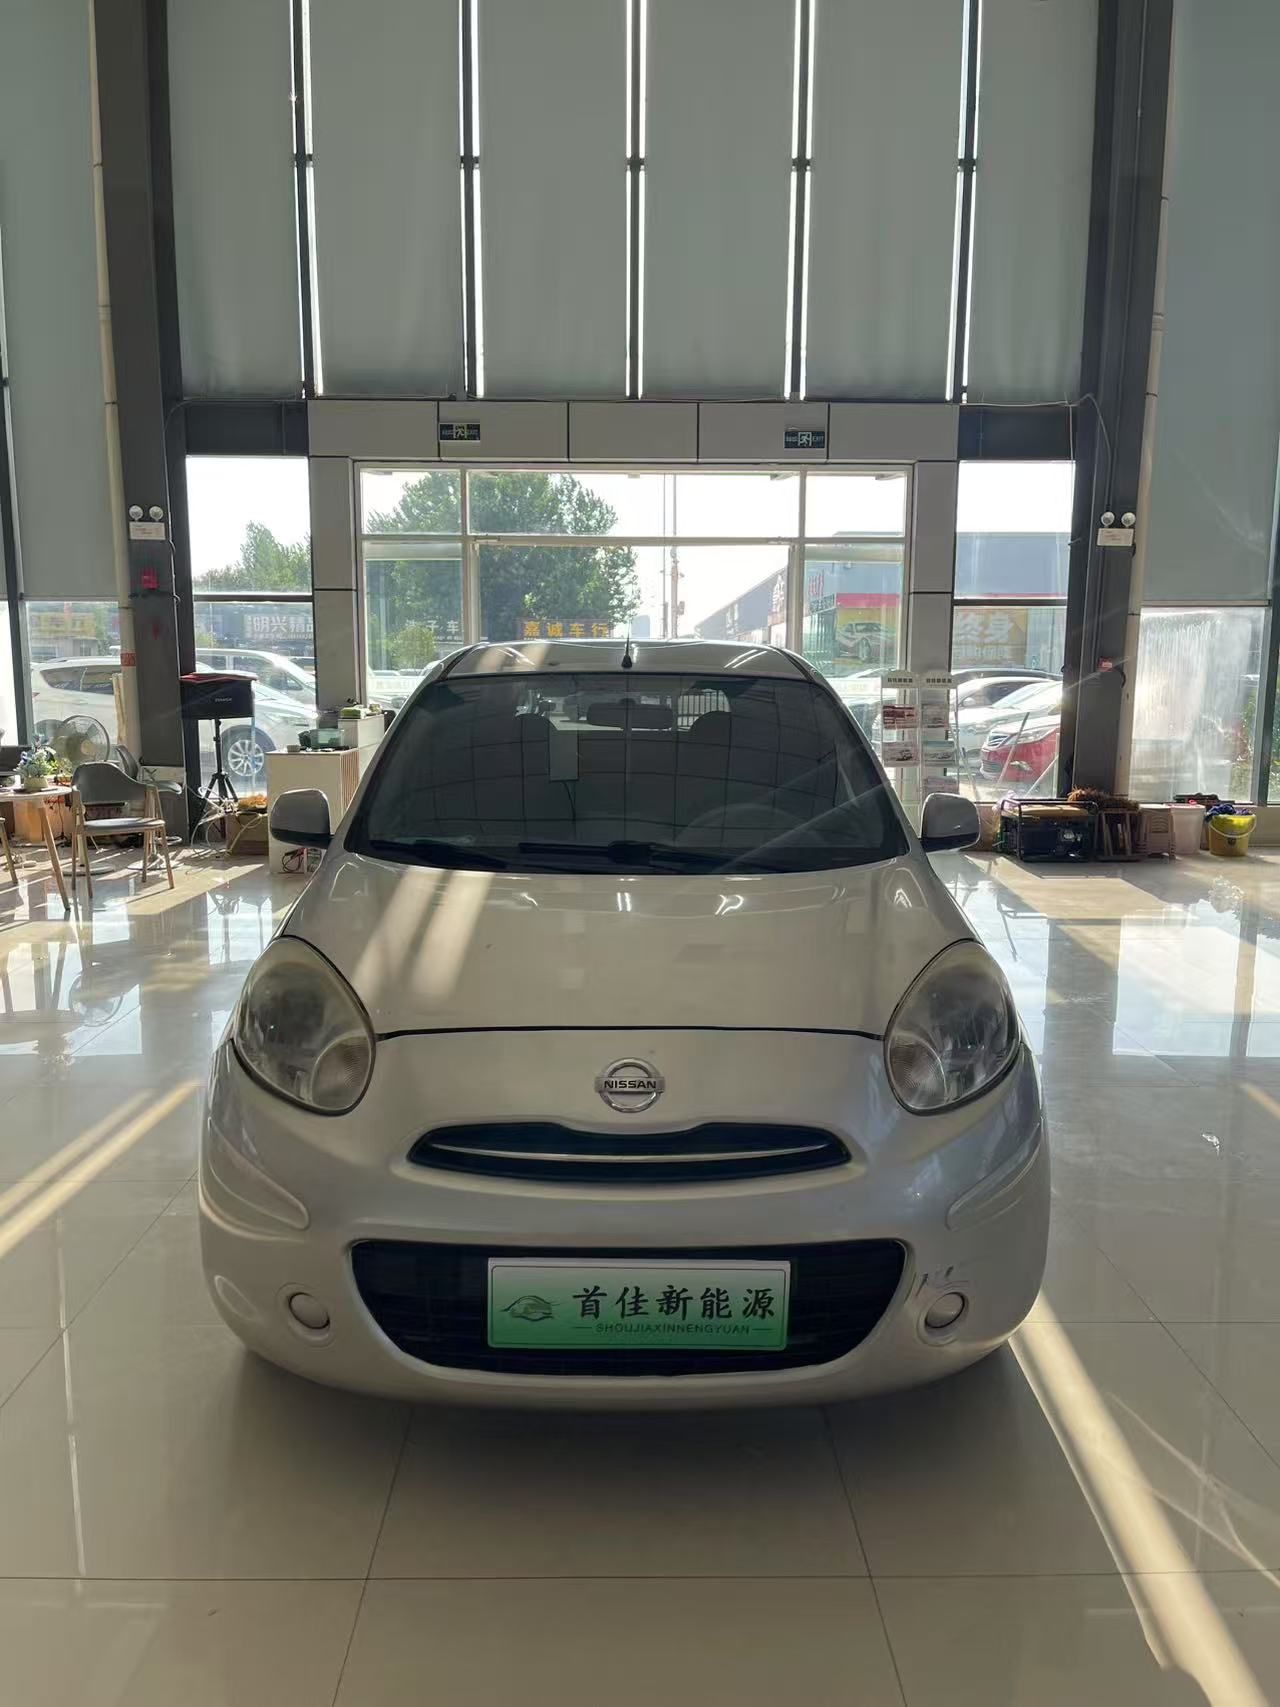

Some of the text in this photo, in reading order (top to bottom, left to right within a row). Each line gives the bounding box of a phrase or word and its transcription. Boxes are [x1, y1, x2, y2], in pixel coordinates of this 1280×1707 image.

[524, 621, 608, 638] 嘉诚车行
[604, 1080, 657, 1089] NISSAN
[572, 1285, 775, 1320] 首佳新能源
[595, 1323, 750, 1336] SHOUJIAXINNENGYUAN
